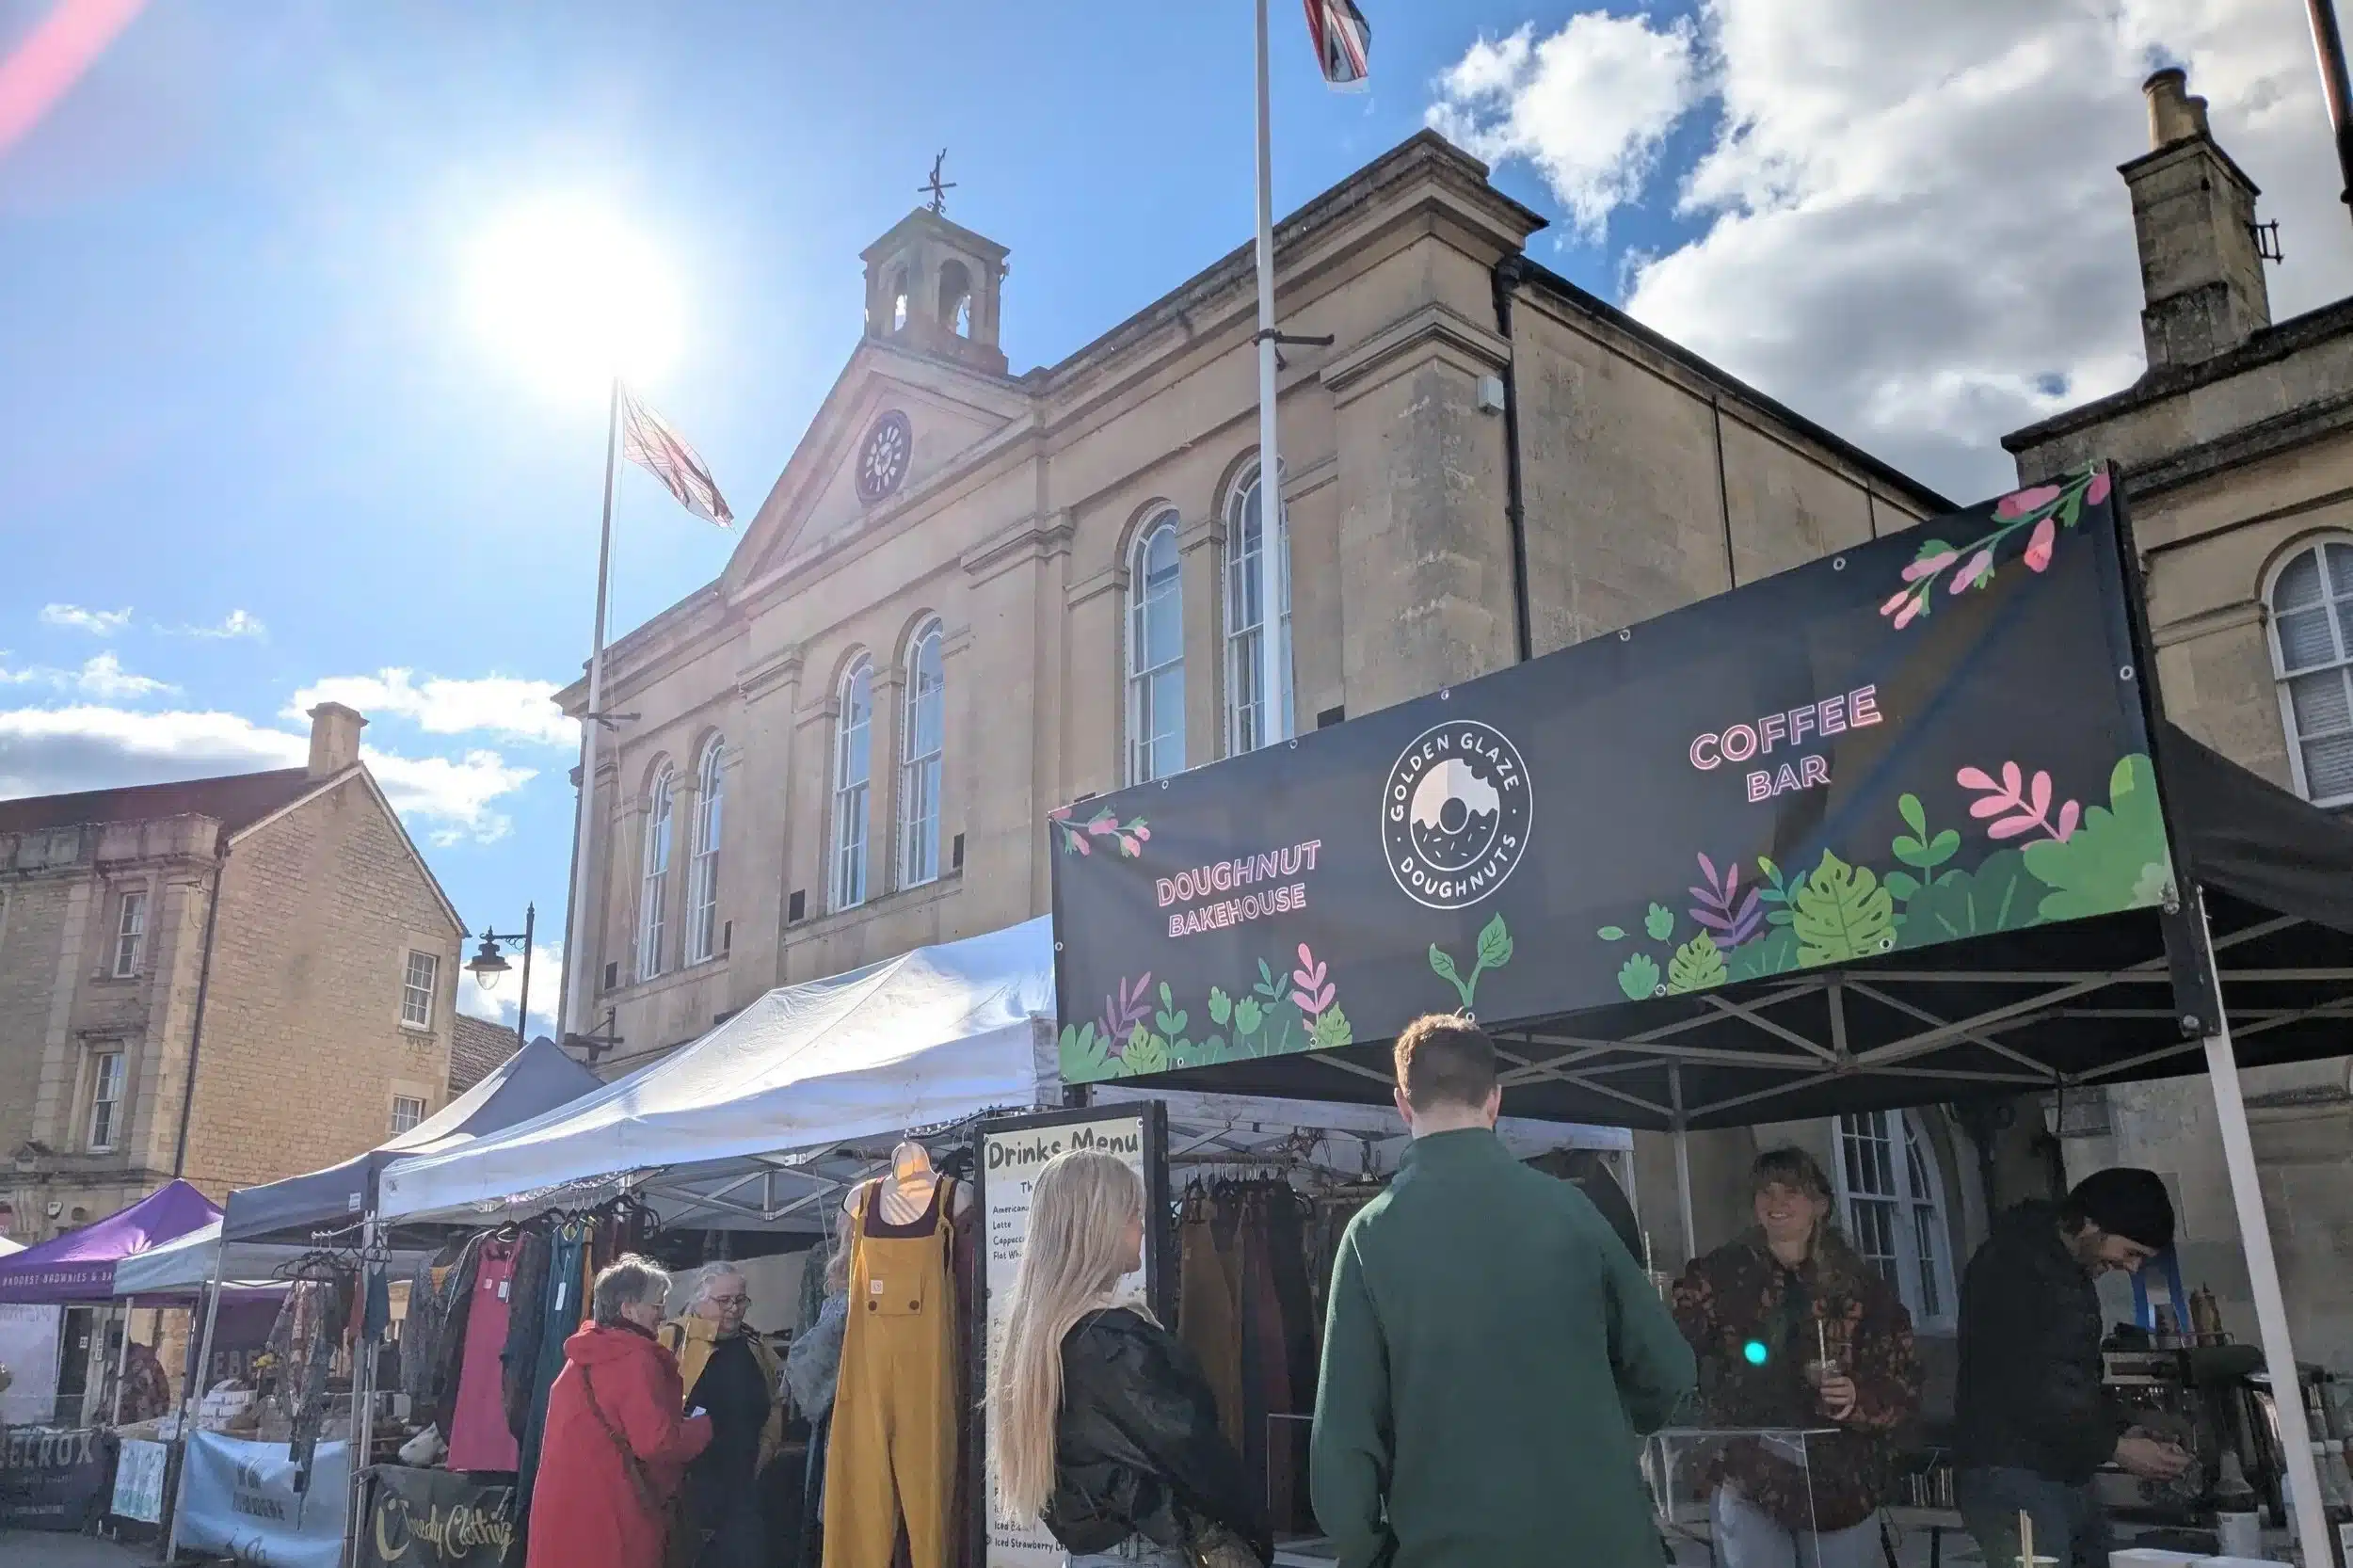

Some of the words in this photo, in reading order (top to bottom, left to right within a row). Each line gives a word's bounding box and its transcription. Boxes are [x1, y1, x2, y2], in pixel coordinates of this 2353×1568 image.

[1689, 684, 1882, 770] COFFEE
[1390, 734, 1449, 822] GOLDEN
[1460, 732, 1519, 792] GLAZE
[1746, 755, 1832, 803] BAR
[1156, 840, 1321, 907] DOUGHNUT
[1401, 834, 1516, 898] DOUGHNUTS
[1168, 883, 1306, 937] BAKEHOUSE
[988, 1135, 1062, 1169] Drinks
[1071, 1128, 1139, 1154] Menu
[1020, 1180, 1033, 1193] Th
[993, 1221, 1011, 1230] Latte
[993, 1251, 1007, 1261] Flat
[995, 1537, 1010, 1548] Iced
[1011, 1538, 1053, 1555] Strawberry
